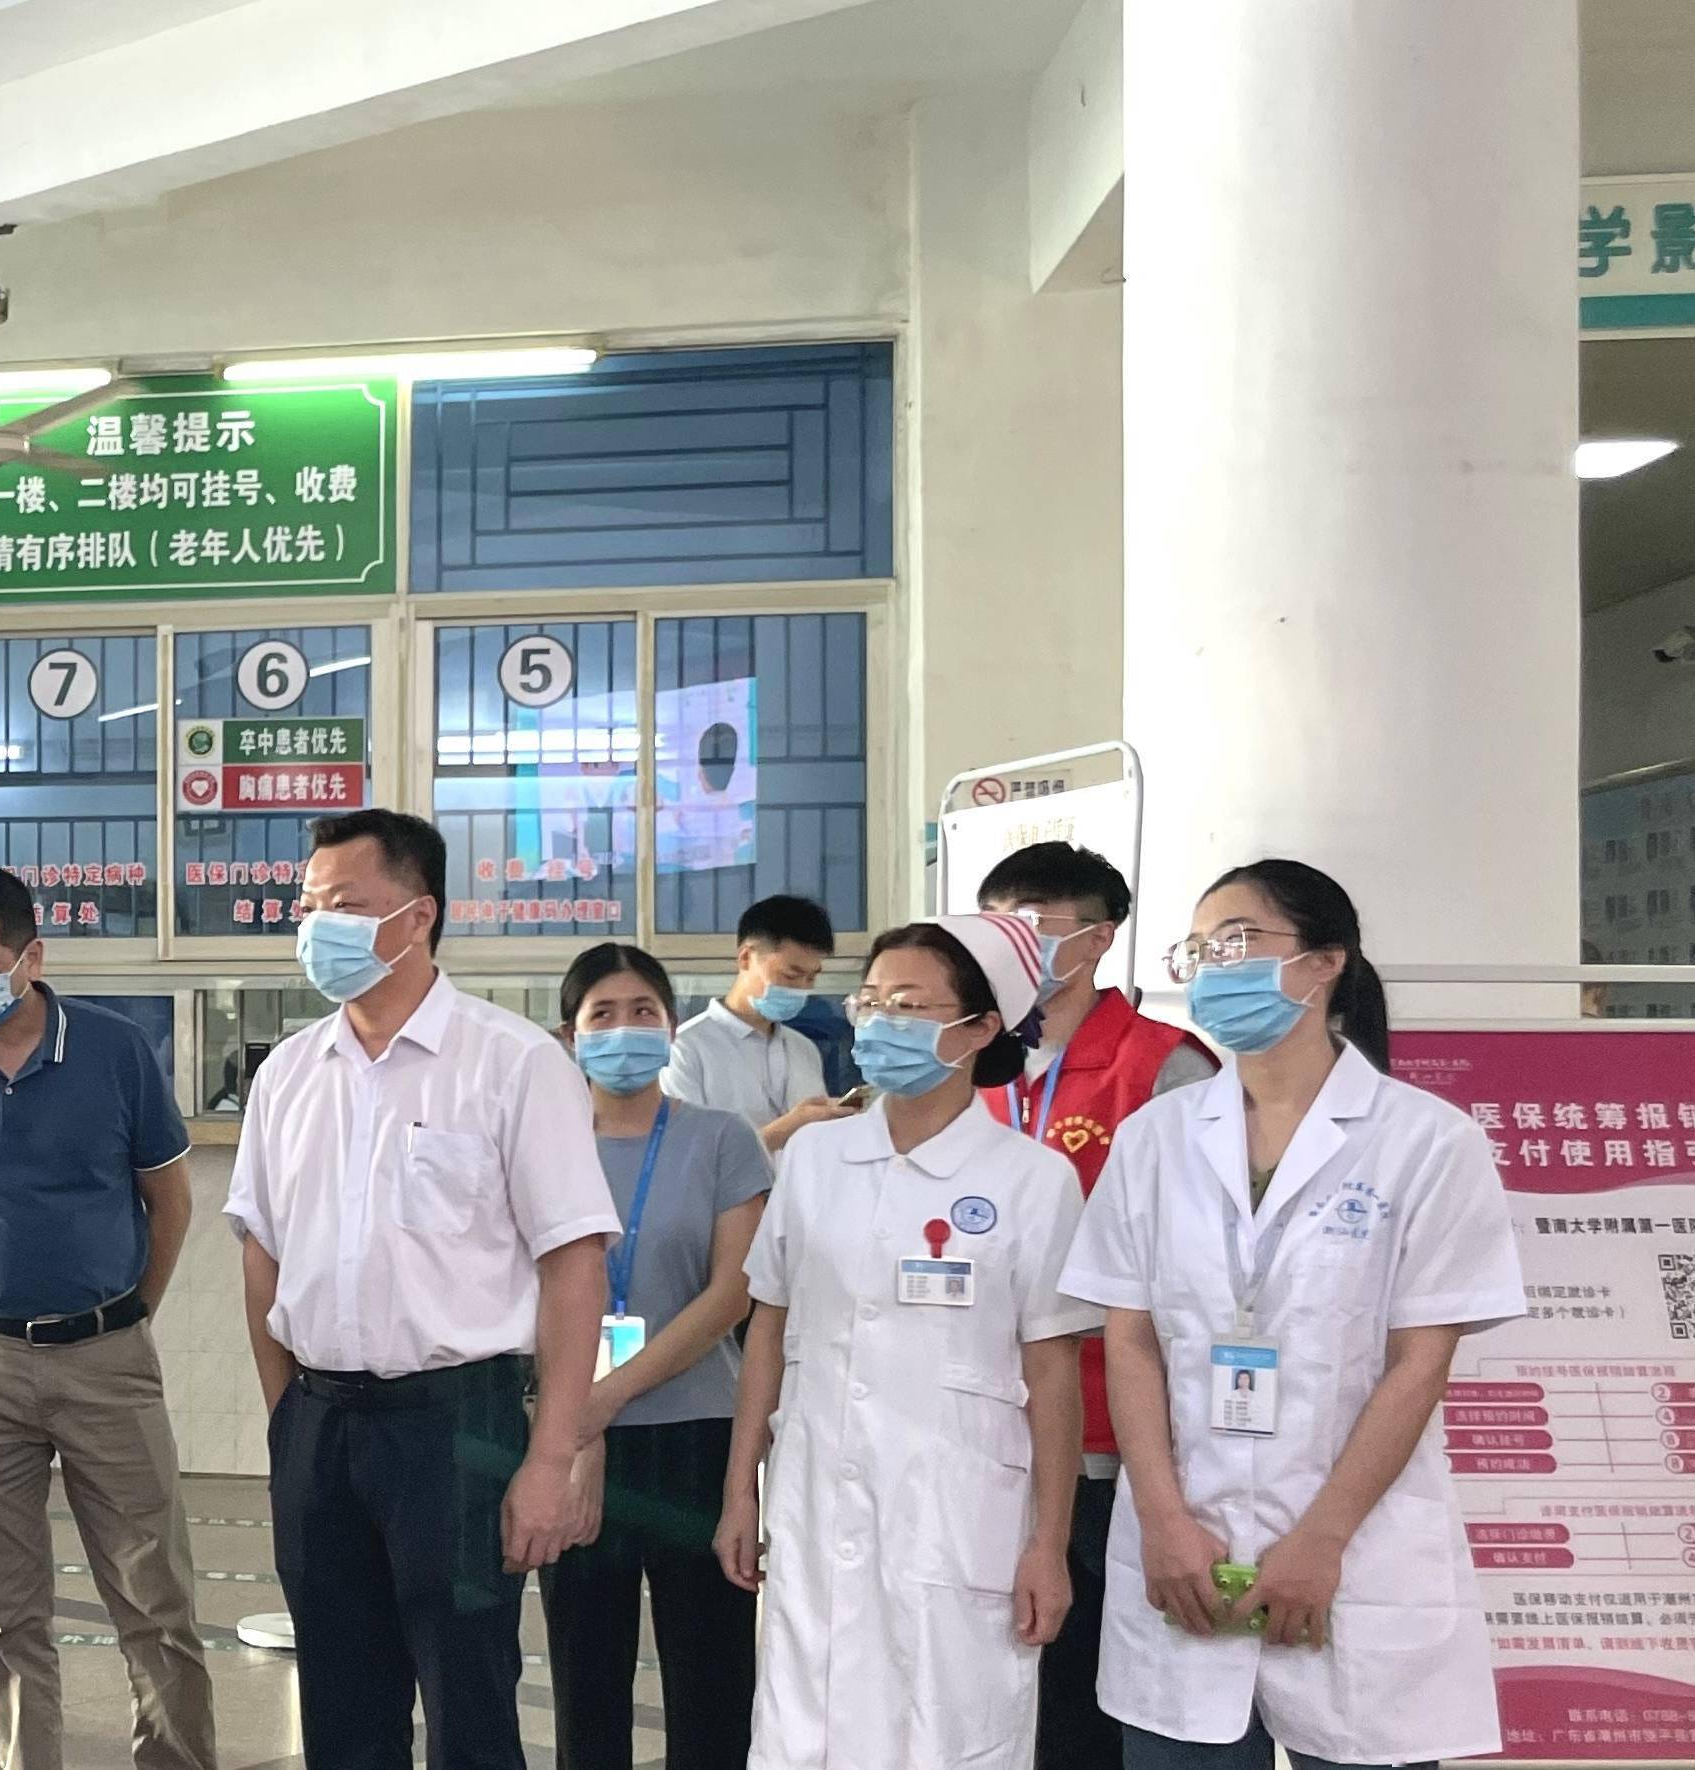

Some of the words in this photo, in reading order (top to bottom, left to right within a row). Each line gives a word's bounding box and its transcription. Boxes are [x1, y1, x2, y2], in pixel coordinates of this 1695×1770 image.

[86, 410, 256, 457] 温馨提示
[48, 663, 78, 706] 7
[255, 653, 289, 697] 6
[520, 648, 552, 694] 5
[239, 726, 347, 756] 卒中患者优先
[238, 772, 347, 801] 胸痛患者优先
